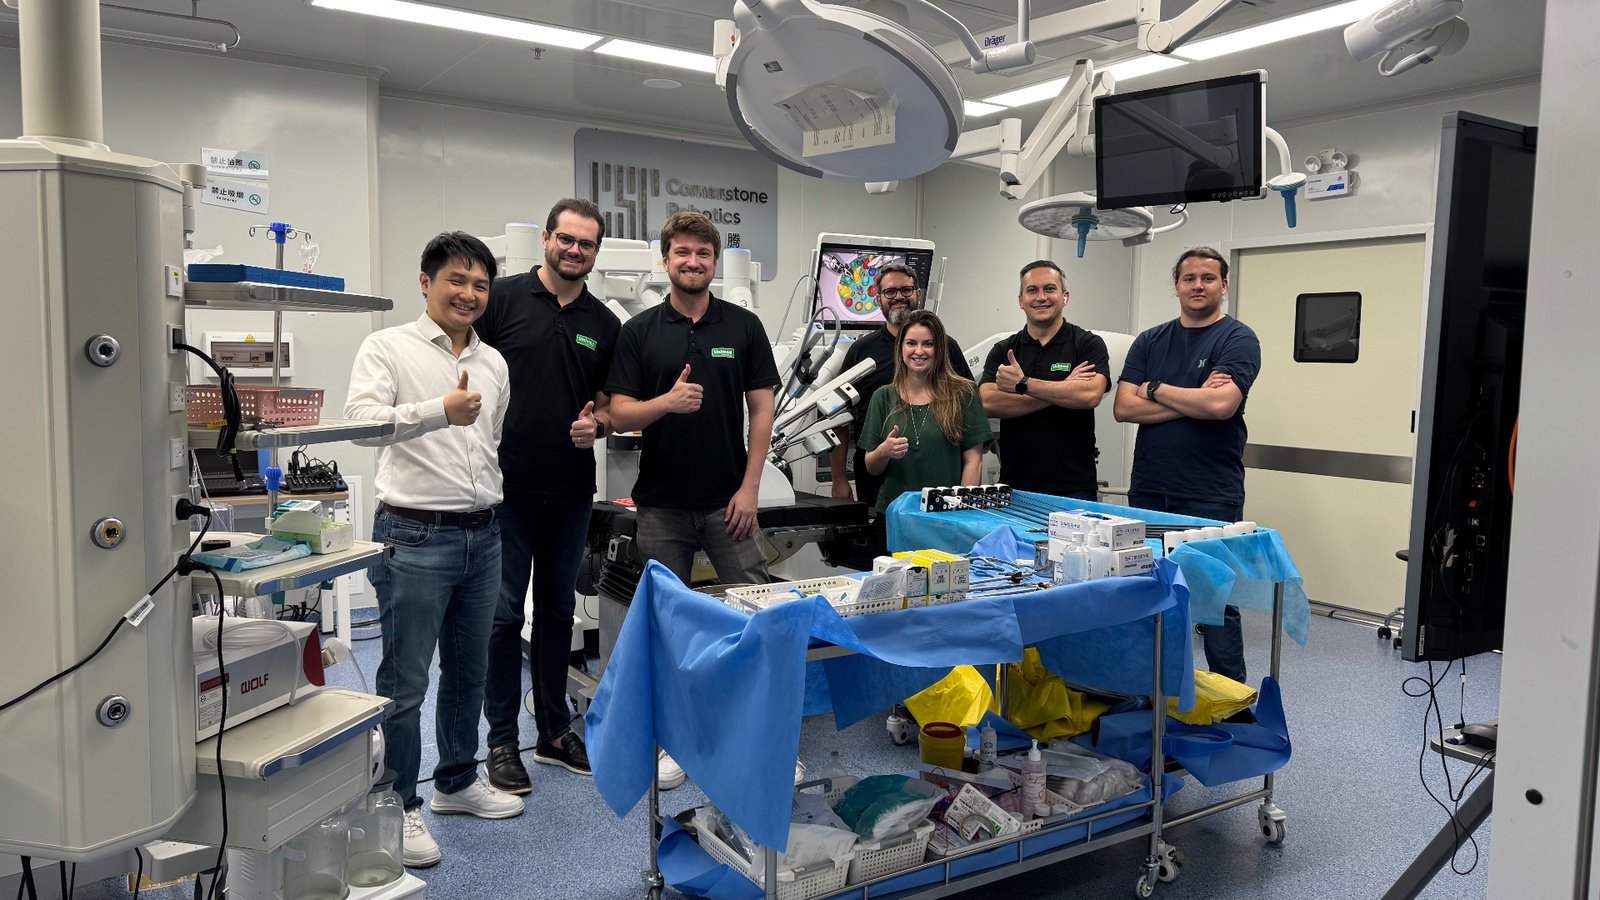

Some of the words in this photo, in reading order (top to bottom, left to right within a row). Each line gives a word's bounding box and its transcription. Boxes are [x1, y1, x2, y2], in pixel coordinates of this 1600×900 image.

[984, 35, 1006, 46] Dräger
[665, 177, 769, 204] Cornerstone
[240, 673, 269, 694] WOLF
